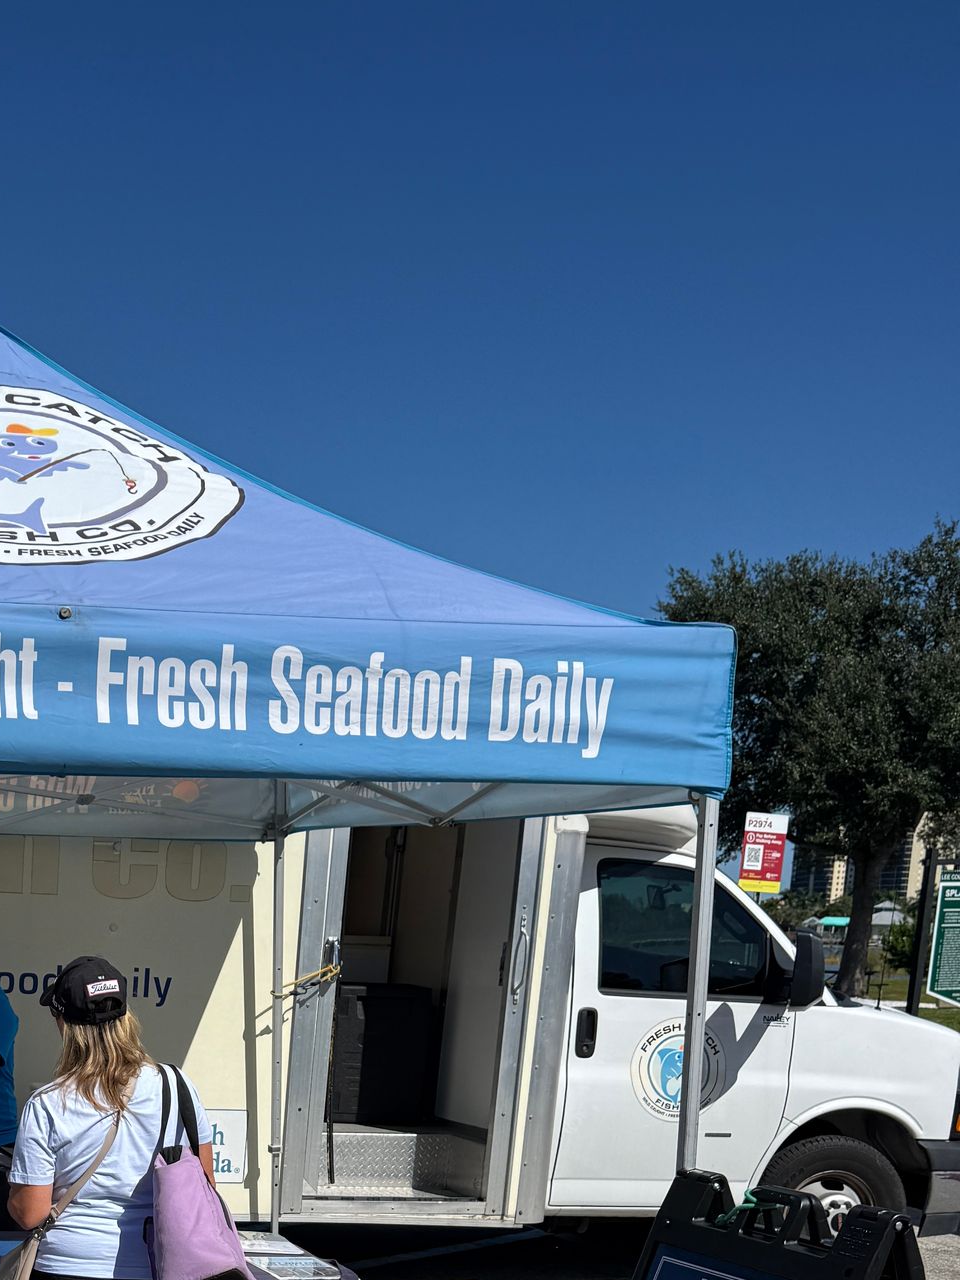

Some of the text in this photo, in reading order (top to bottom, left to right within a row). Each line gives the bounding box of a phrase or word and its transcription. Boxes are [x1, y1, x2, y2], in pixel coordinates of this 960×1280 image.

[4, 393, 184, 463] CATCH
[17, 547, 83, 558] FRESH
[87, 530, 167, 558] SEAFOOD
[168, 511, 205, 538] DAILY
[76, 517, 155, 538] CO.
[96, 636, 248, 731] Fresh
[268, 644, 473, 742] Seafood
[487, 656, 615, 759] Daily
[748, 819, 773, 829] P2974
[640, 1023, 682, 1053] FRESH
[655, 1098, 680, 1111] FISH
